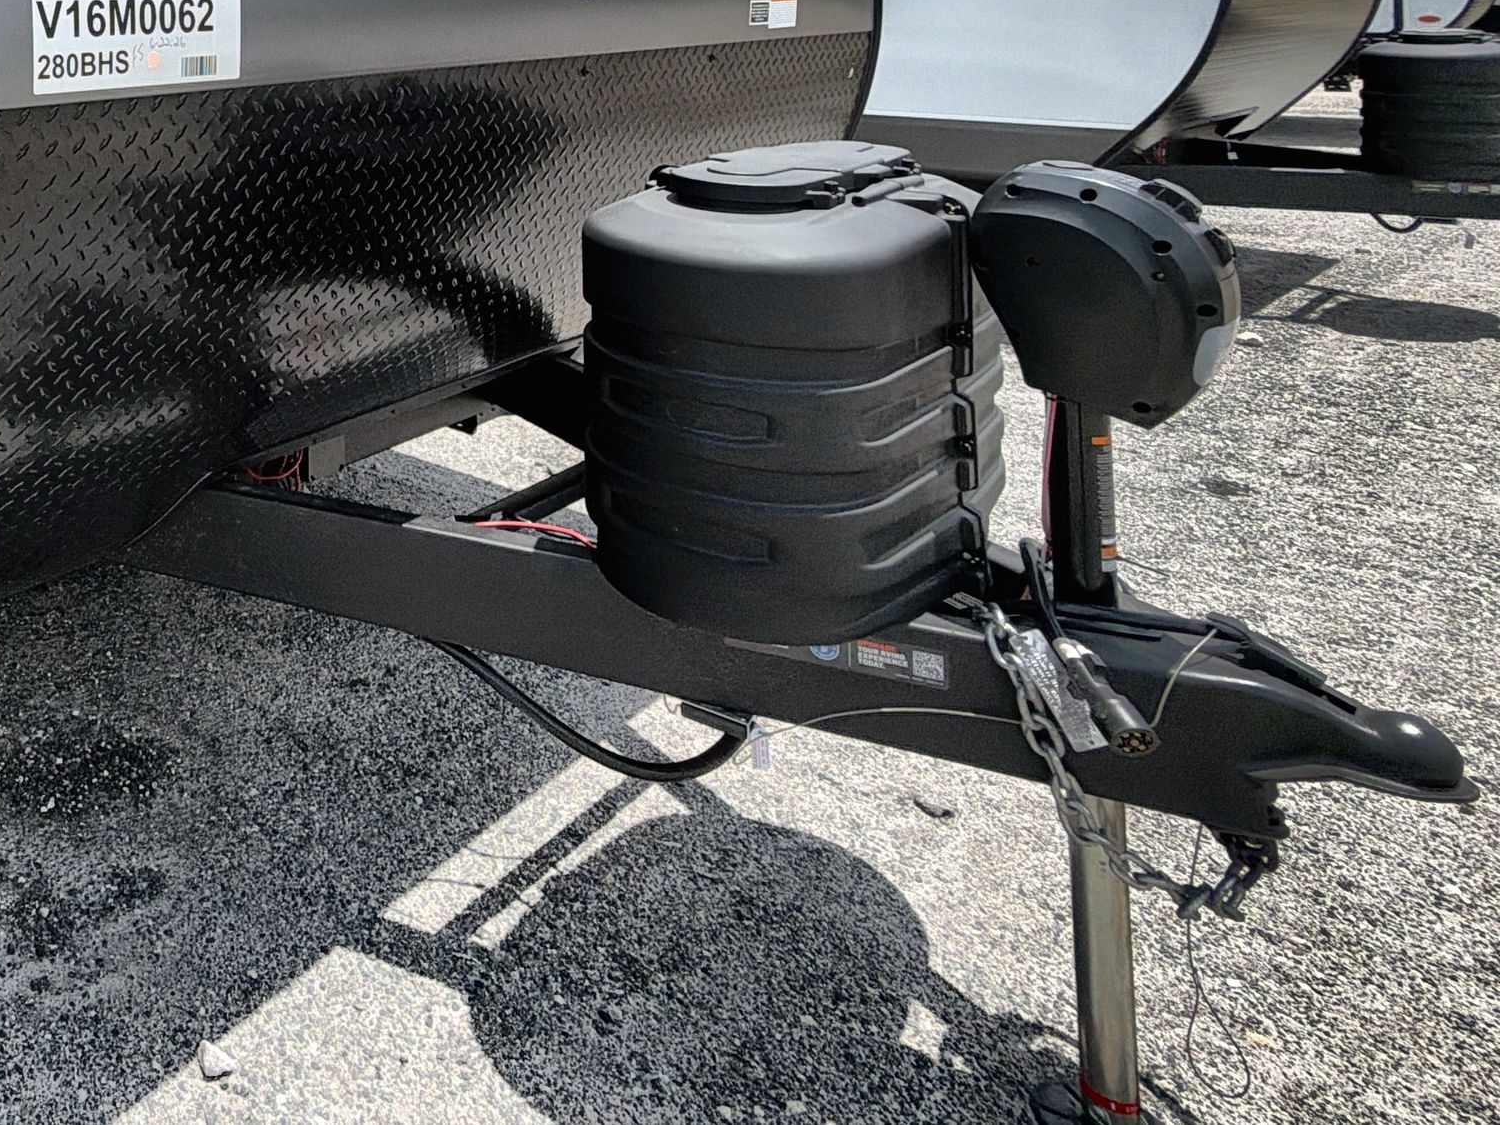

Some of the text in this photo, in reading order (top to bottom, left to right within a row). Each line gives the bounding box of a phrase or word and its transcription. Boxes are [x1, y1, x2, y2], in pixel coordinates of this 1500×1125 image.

[37, 50, 130, 80] 280BHS
[857, 645, 880, 655] YOUR
[857, 651, 909, 668] EXPERIENCE
